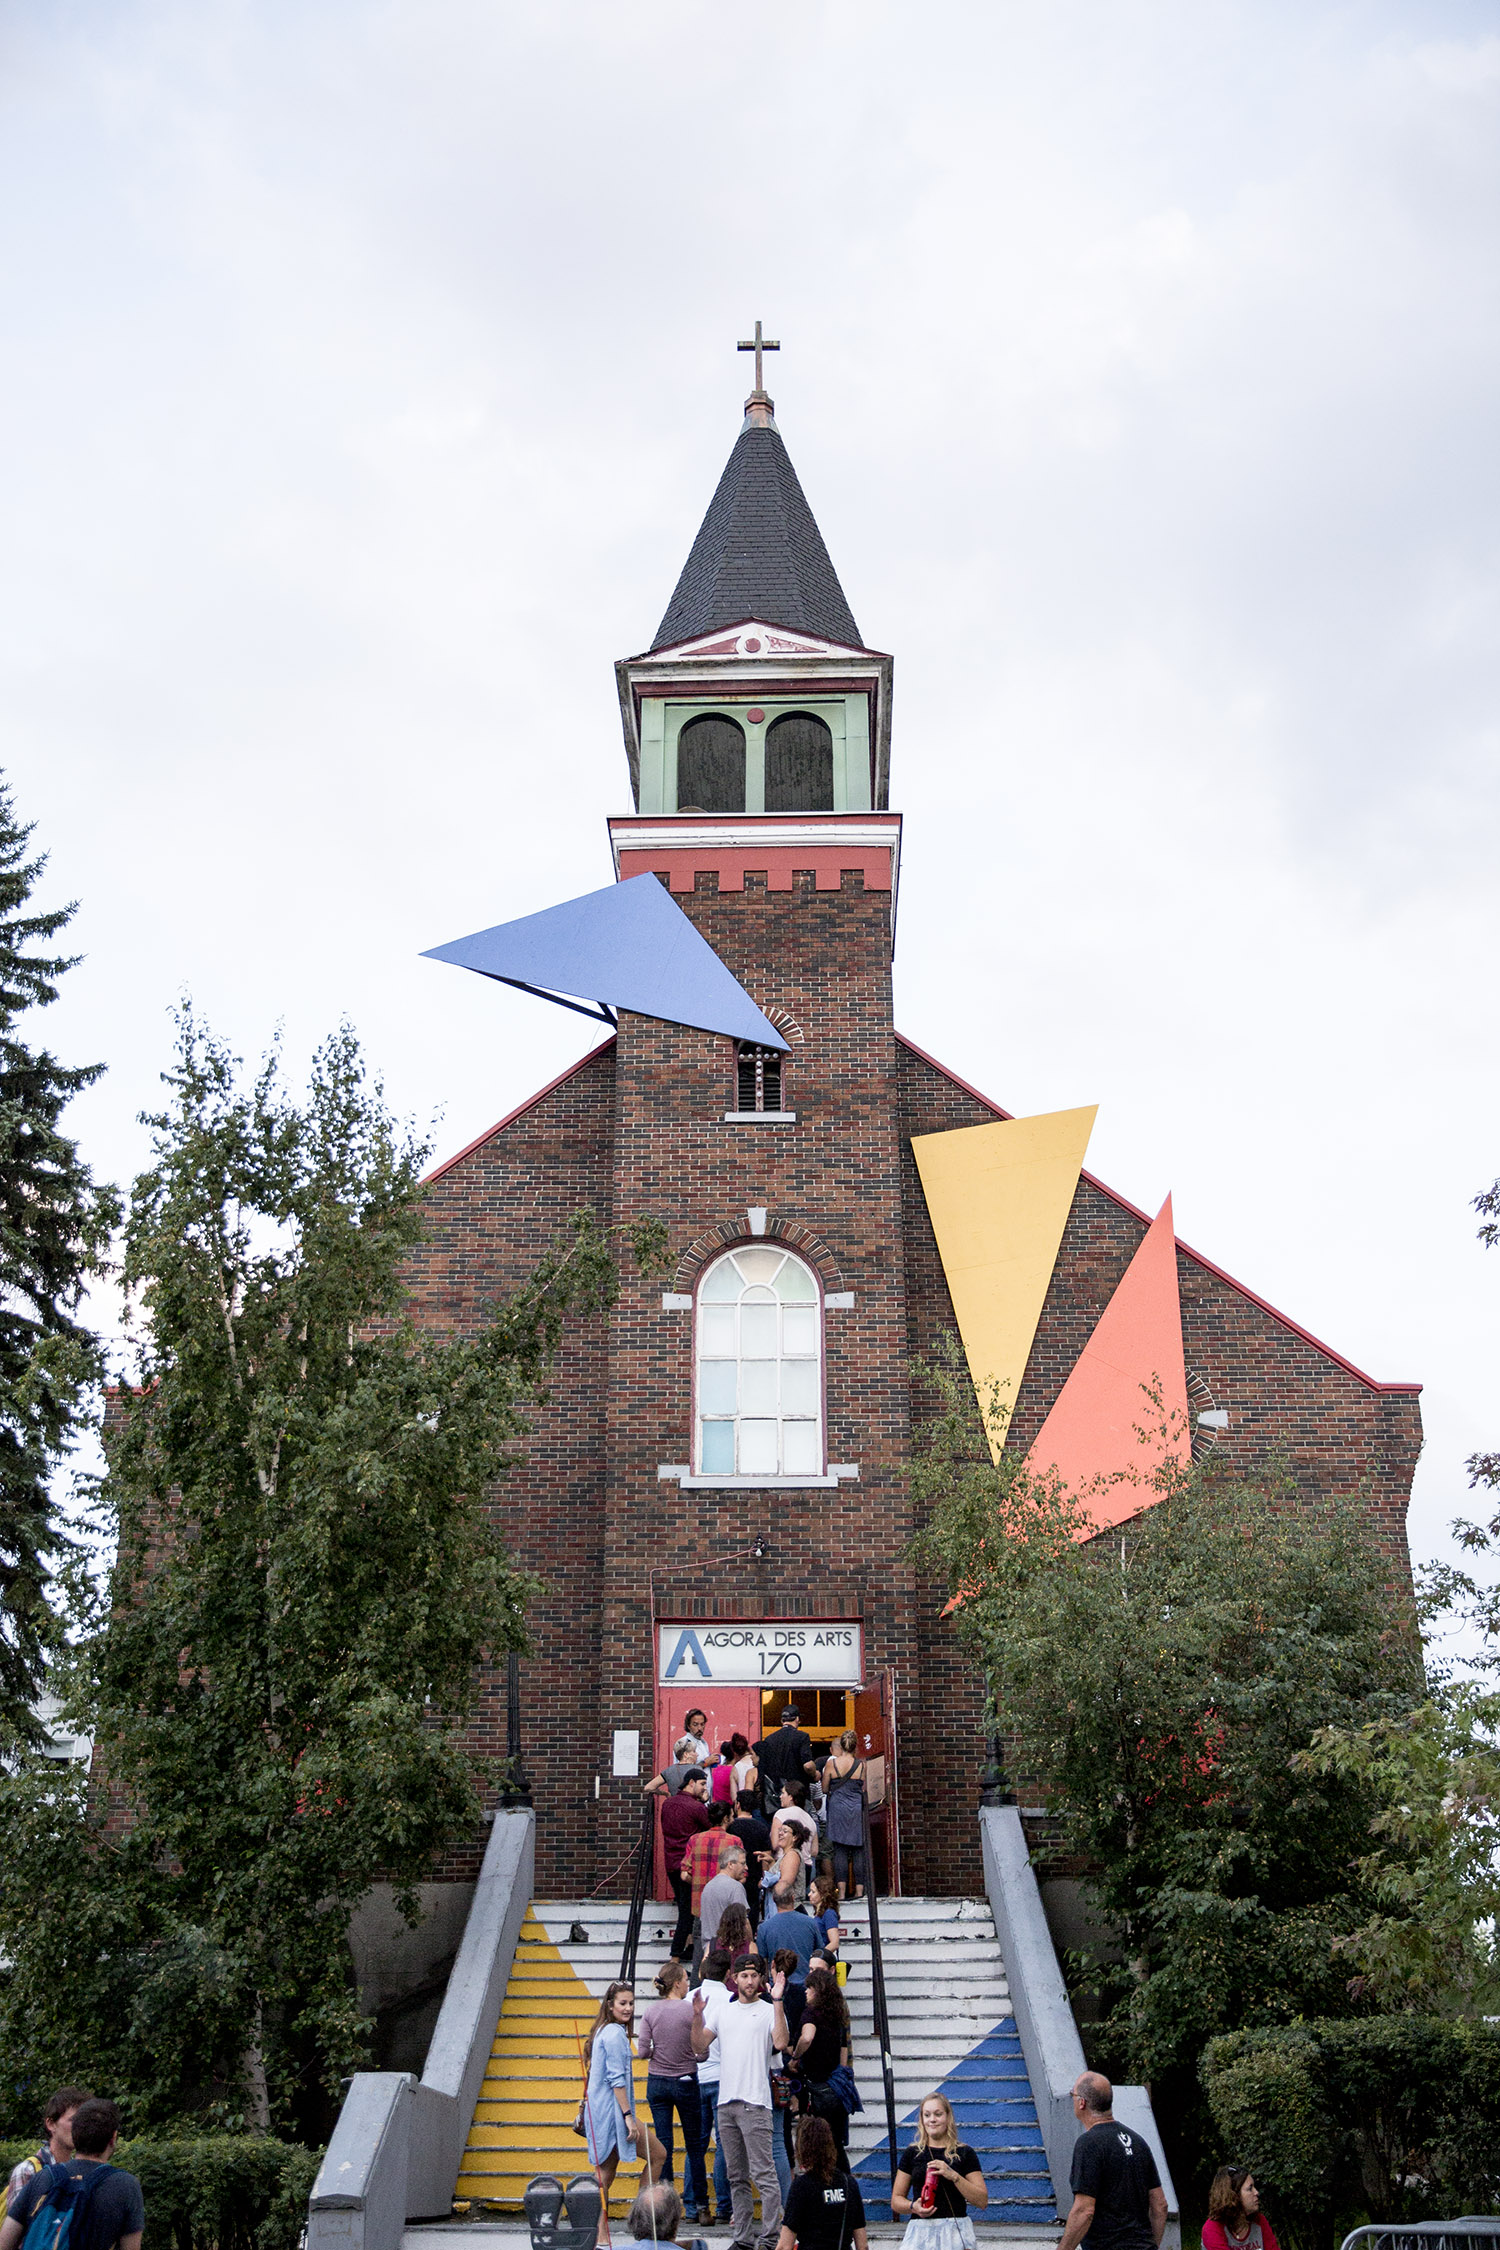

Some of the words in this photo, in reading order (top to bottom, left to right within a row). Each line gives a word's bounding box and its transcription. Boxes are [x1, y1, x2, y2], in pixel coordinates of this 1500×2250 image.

[703, 1632, 767, 1647] AGORA
[774, 1631, 806, 1646] DES
[813, 1631, 852, 1646] ARTS
[758, 1652, 802, 1675] 170
[824, 2188, 846, 2202] FME
